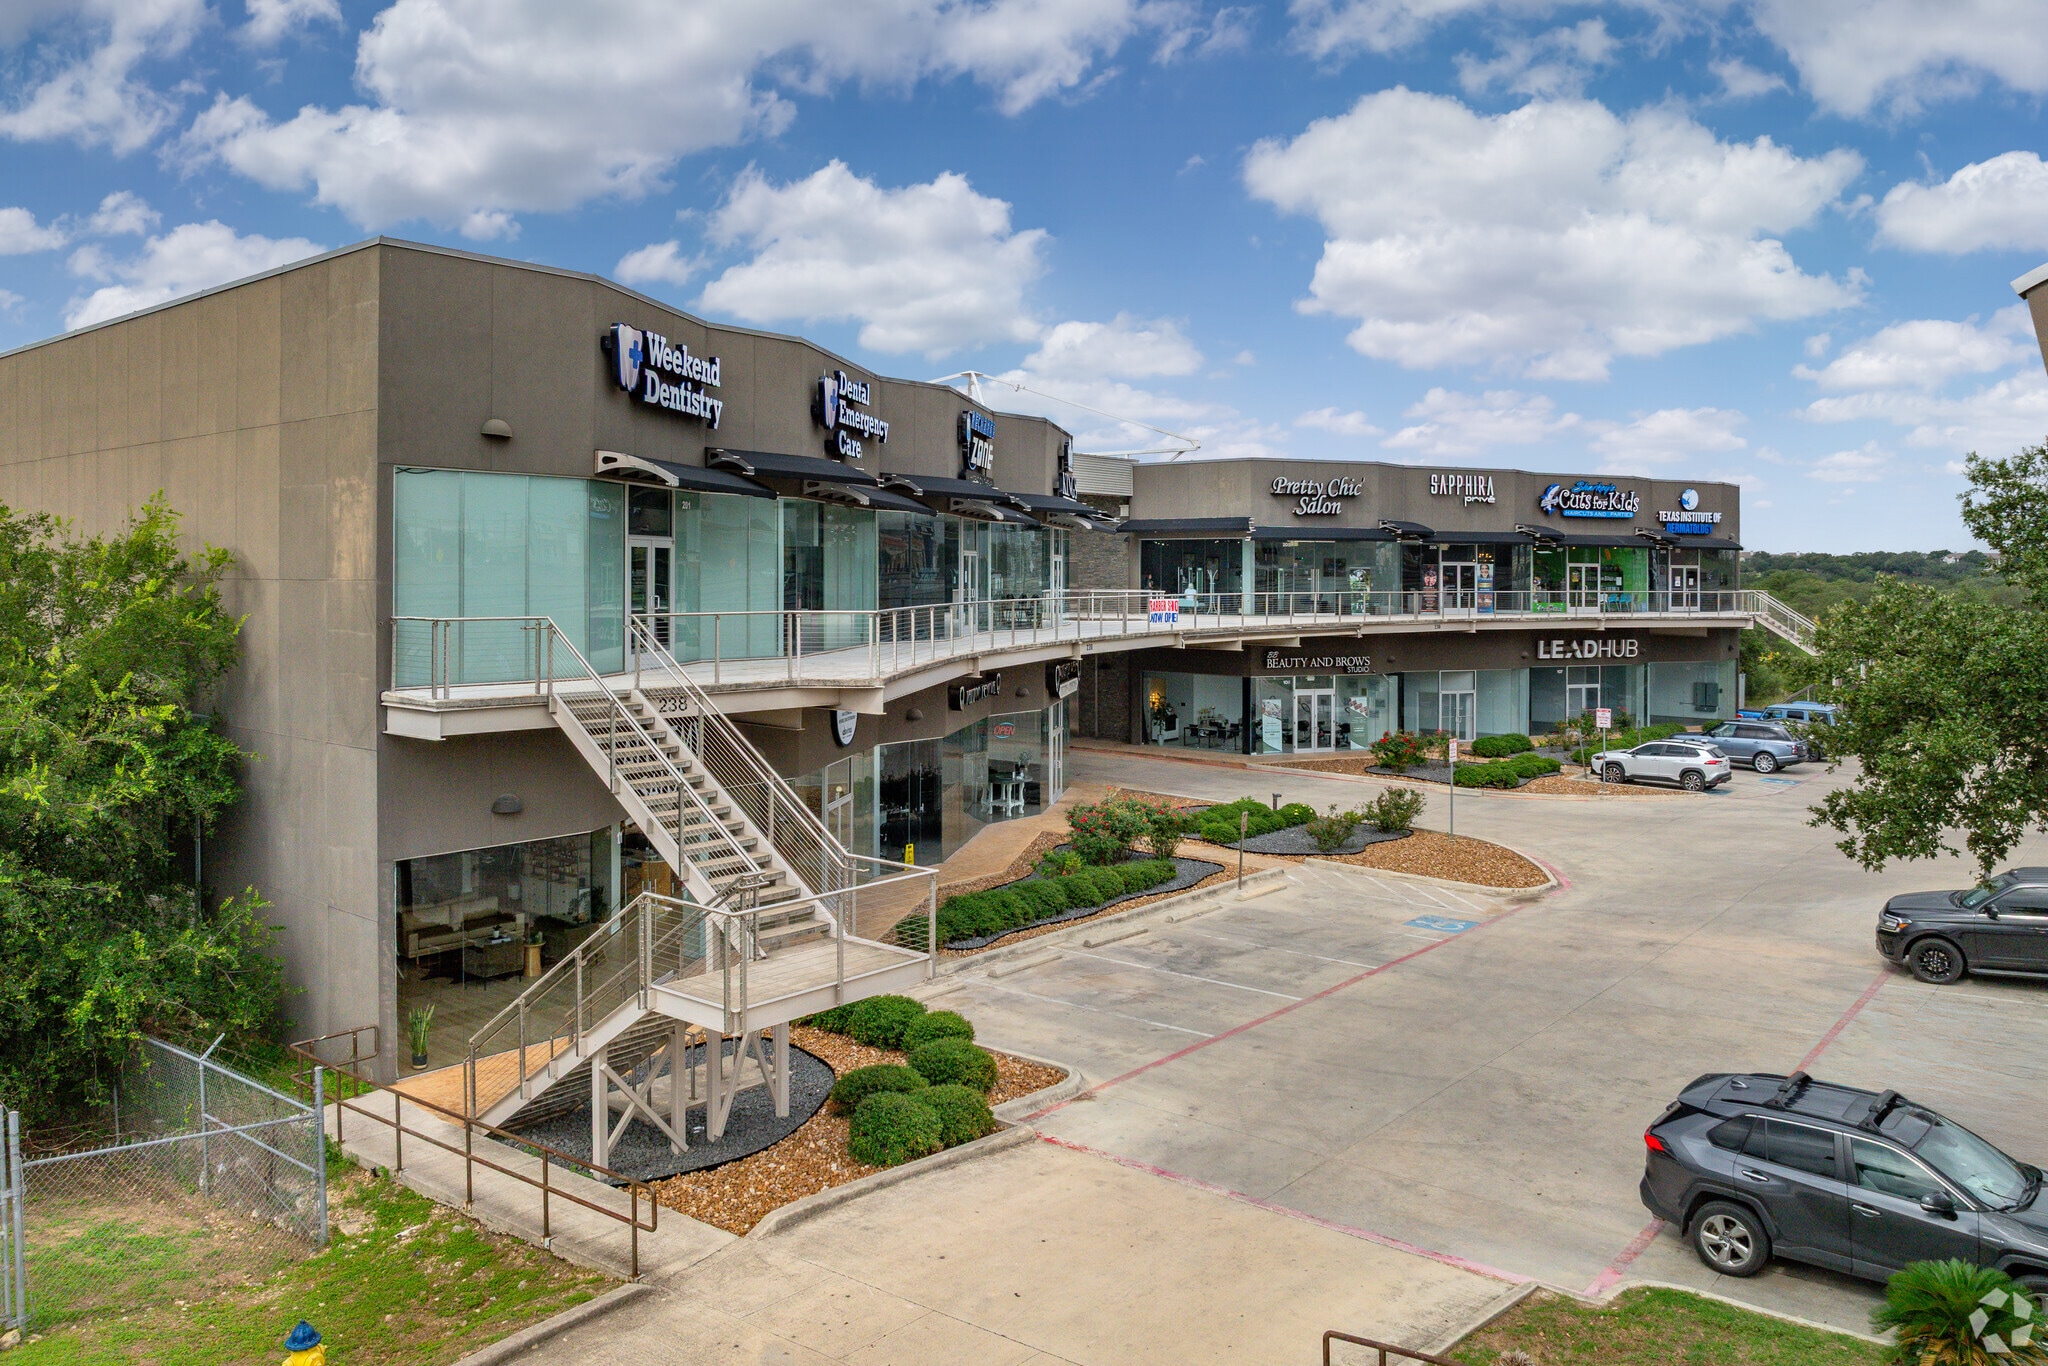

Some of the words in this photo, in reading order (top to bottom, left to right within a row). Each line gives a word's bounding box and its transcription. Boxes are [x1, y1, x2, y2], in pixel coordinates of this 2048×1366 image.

[646, 330, 721, 387] Weekend
[839, 370, 870, 405] Dental
[644, 368, 723, 429] Dentistry
[838, 398, 889, 443] Emergency
[971, 436, 993, 470] ZONE
[1272, 476, 1324, 501] Pretty
[1430, 474, 1494, 496] SAPPHIRA
[1294, 494, 1342, 515] Salon
[1559, 489, 1592, 510] Cuts
[1592, 495, 1609, 510] for
[1607, 491, 1640, 512] Kids
[1659, 511, 1680, 522] TEXAS
[1680, 511, 1713, 523] INSTITUTE
[1713, 512, 1722, 523] OF
[1666, 523, 1714, 535] DERMATOLOGY
[1538, 639, 1639, 659] LEADHUB
[1266, 658, 1308, 669] BEAUTY
[1310, 657, 1334, 668] AND
[1335, 656, 1371, 667] BROWS
[1347, 666, 1370, 674] STUDIO
[659, 696, 688, 713] 238
[994, 725, 1015, 735] OPEN
